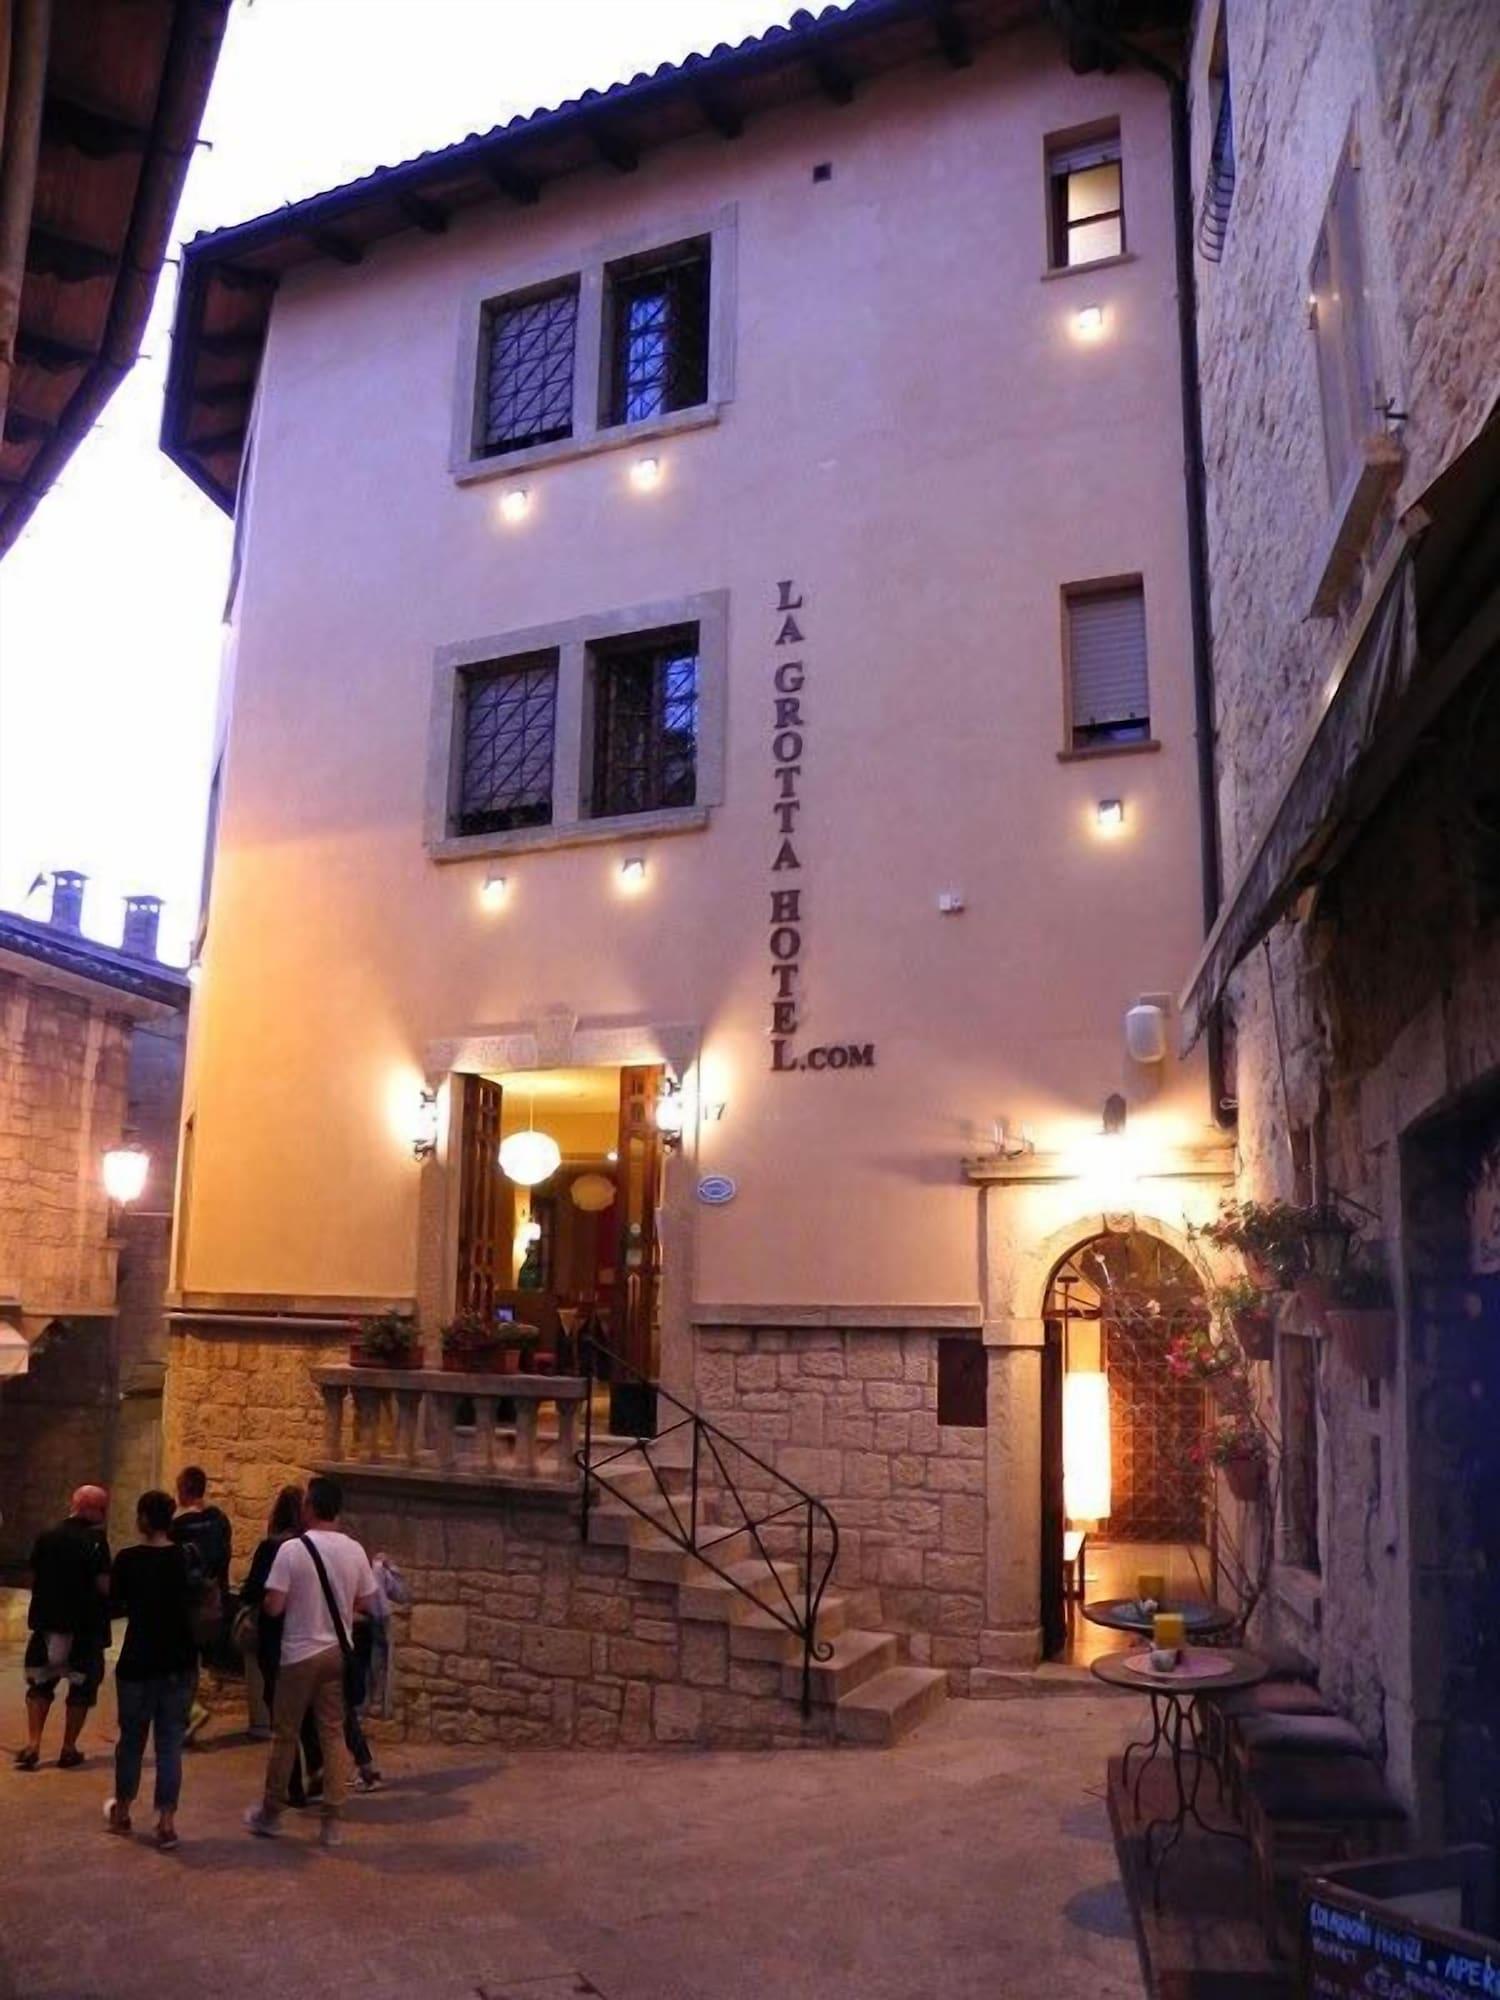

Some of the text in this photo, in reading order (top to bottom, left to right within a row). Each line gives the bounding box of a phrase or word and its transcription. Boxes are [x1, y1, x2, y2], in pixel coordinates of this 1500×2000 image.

[769, 580, 805, 1072] LA GROTTA HOTEL
